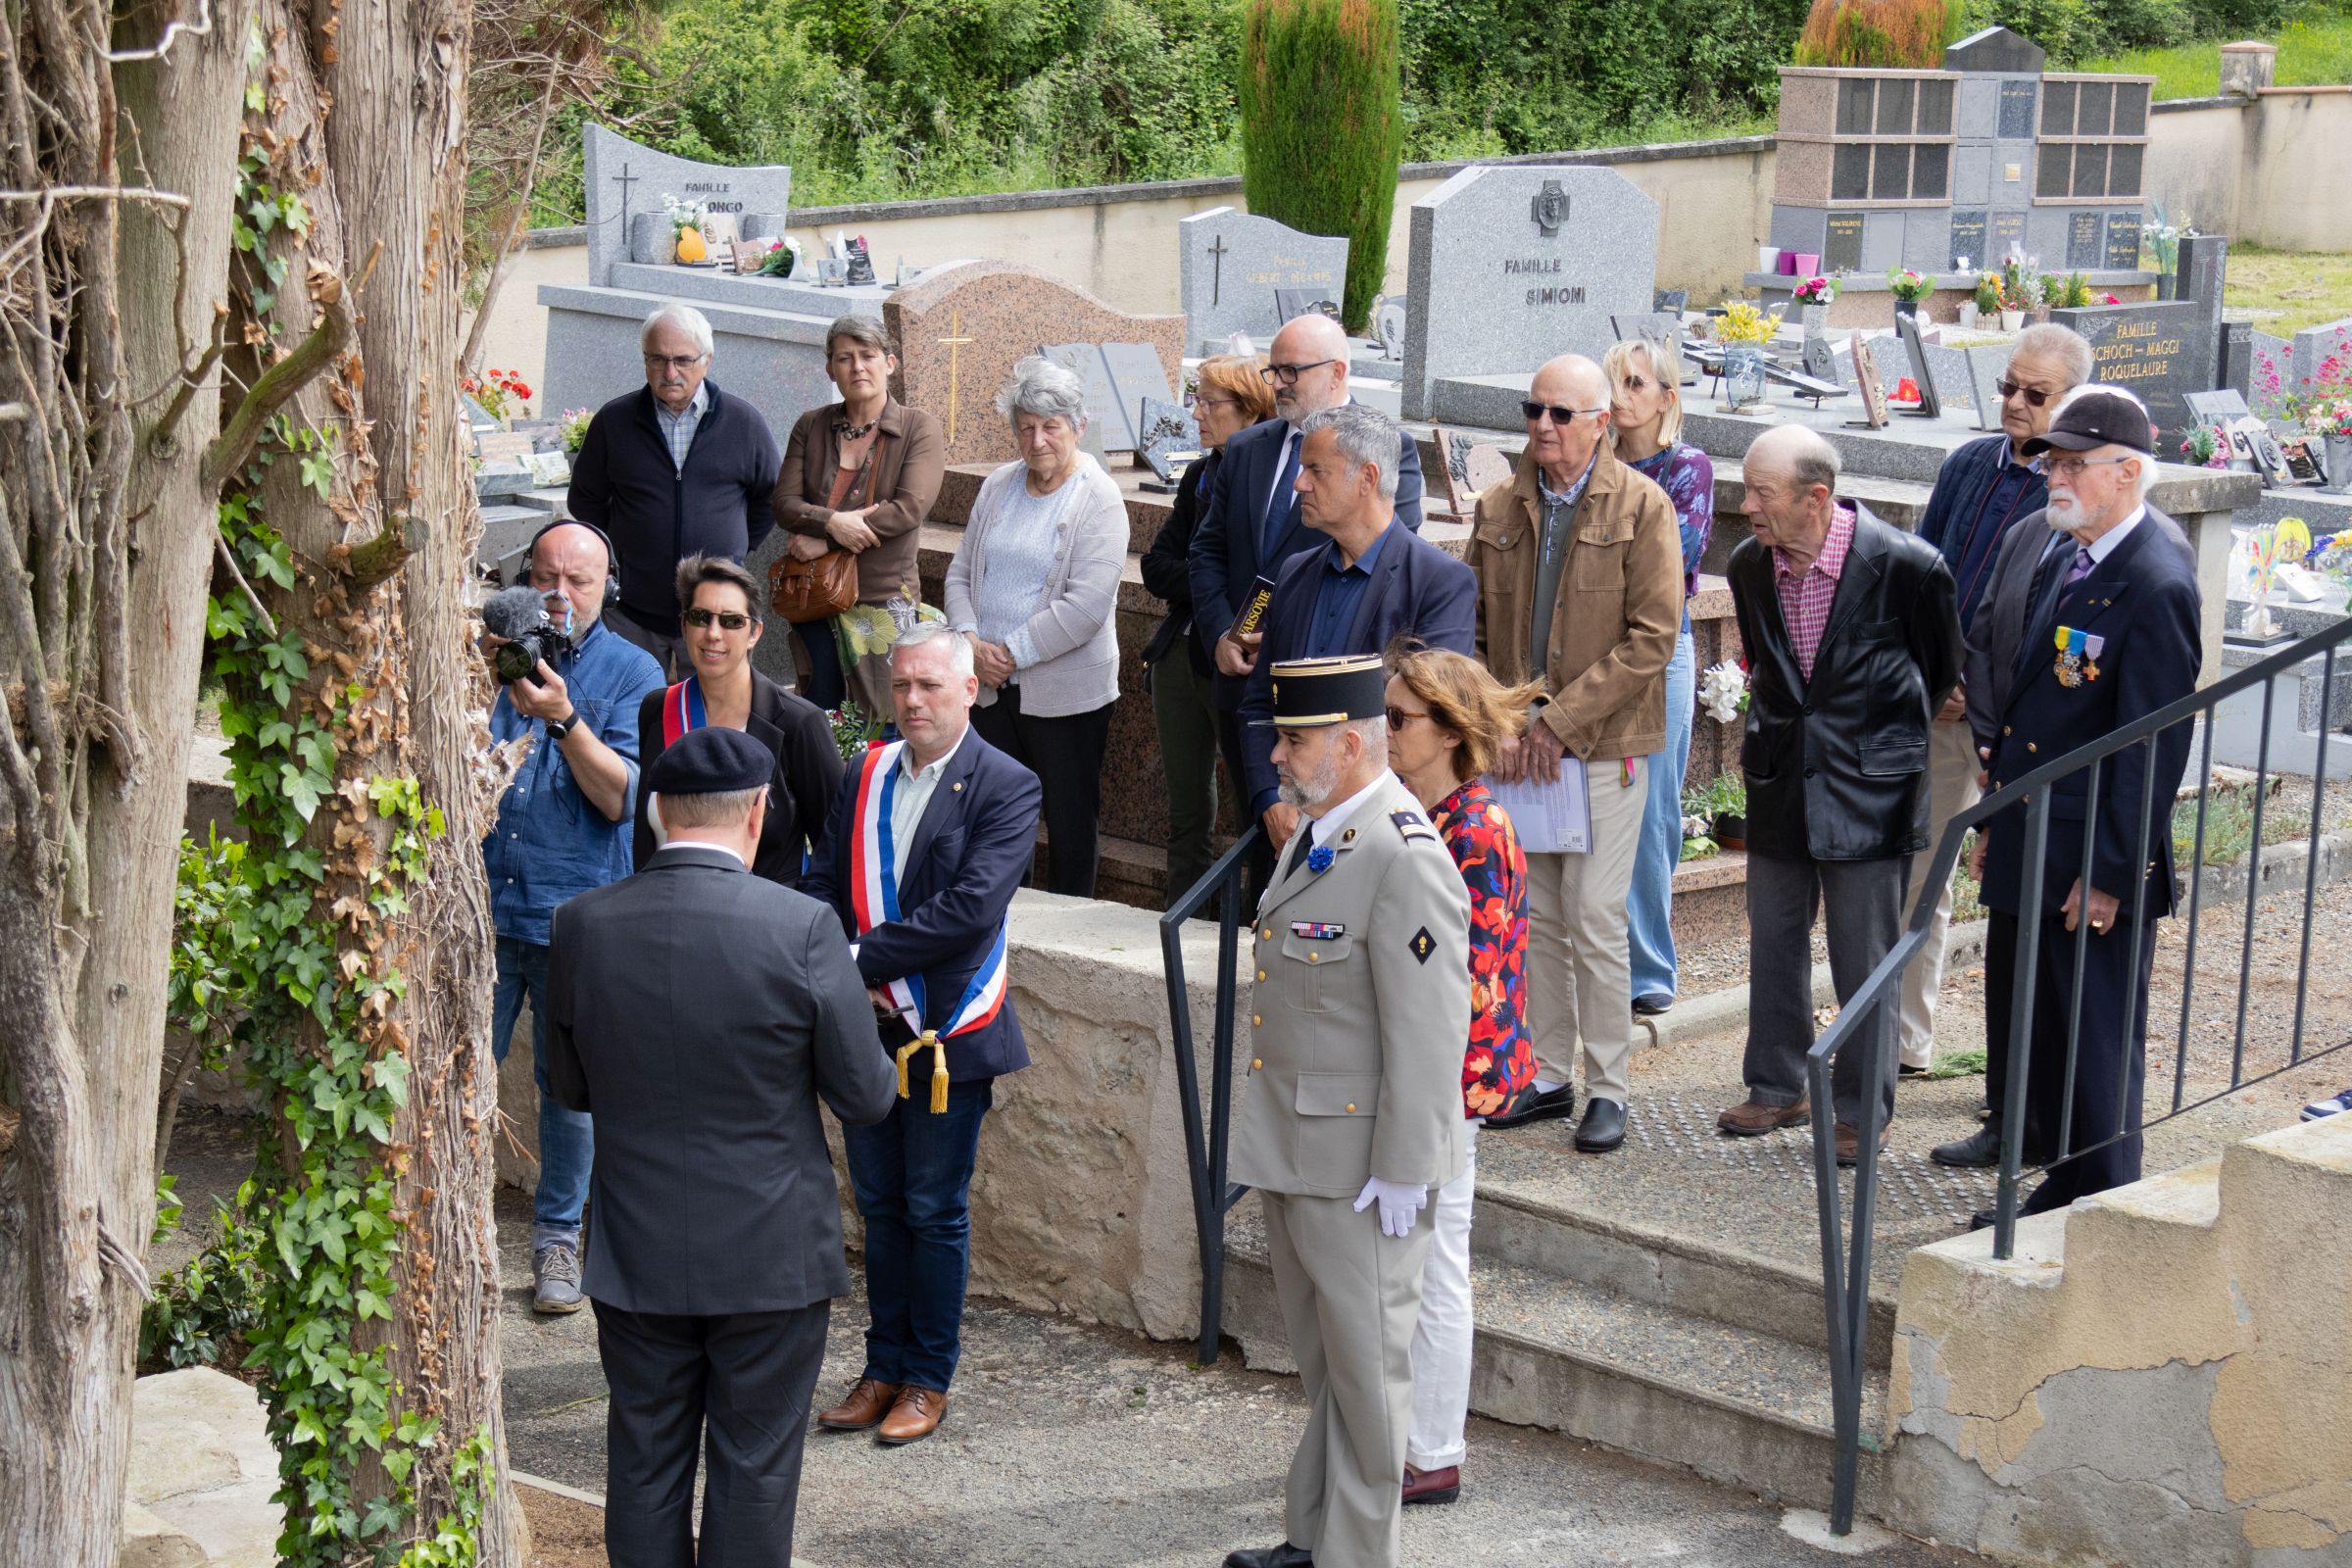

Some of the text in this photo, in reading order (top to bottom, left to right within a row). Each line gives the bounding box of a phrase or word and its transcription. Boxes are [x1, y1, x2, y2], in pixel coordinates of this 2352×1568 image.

[686, 182, 730, 193] FAMILLE
[1504, 258, 1561, 273] FAMILLE
[1526, 286, 1586, 306] SIMIONI
[2116, 321, 2157, 339] FAMILLE
[2091, 343, 2133, 362] SCHOCH
[2146, 339, 2180, 356] MAGGI
[2100, 361, 2169, 381] ROQUELAURE
